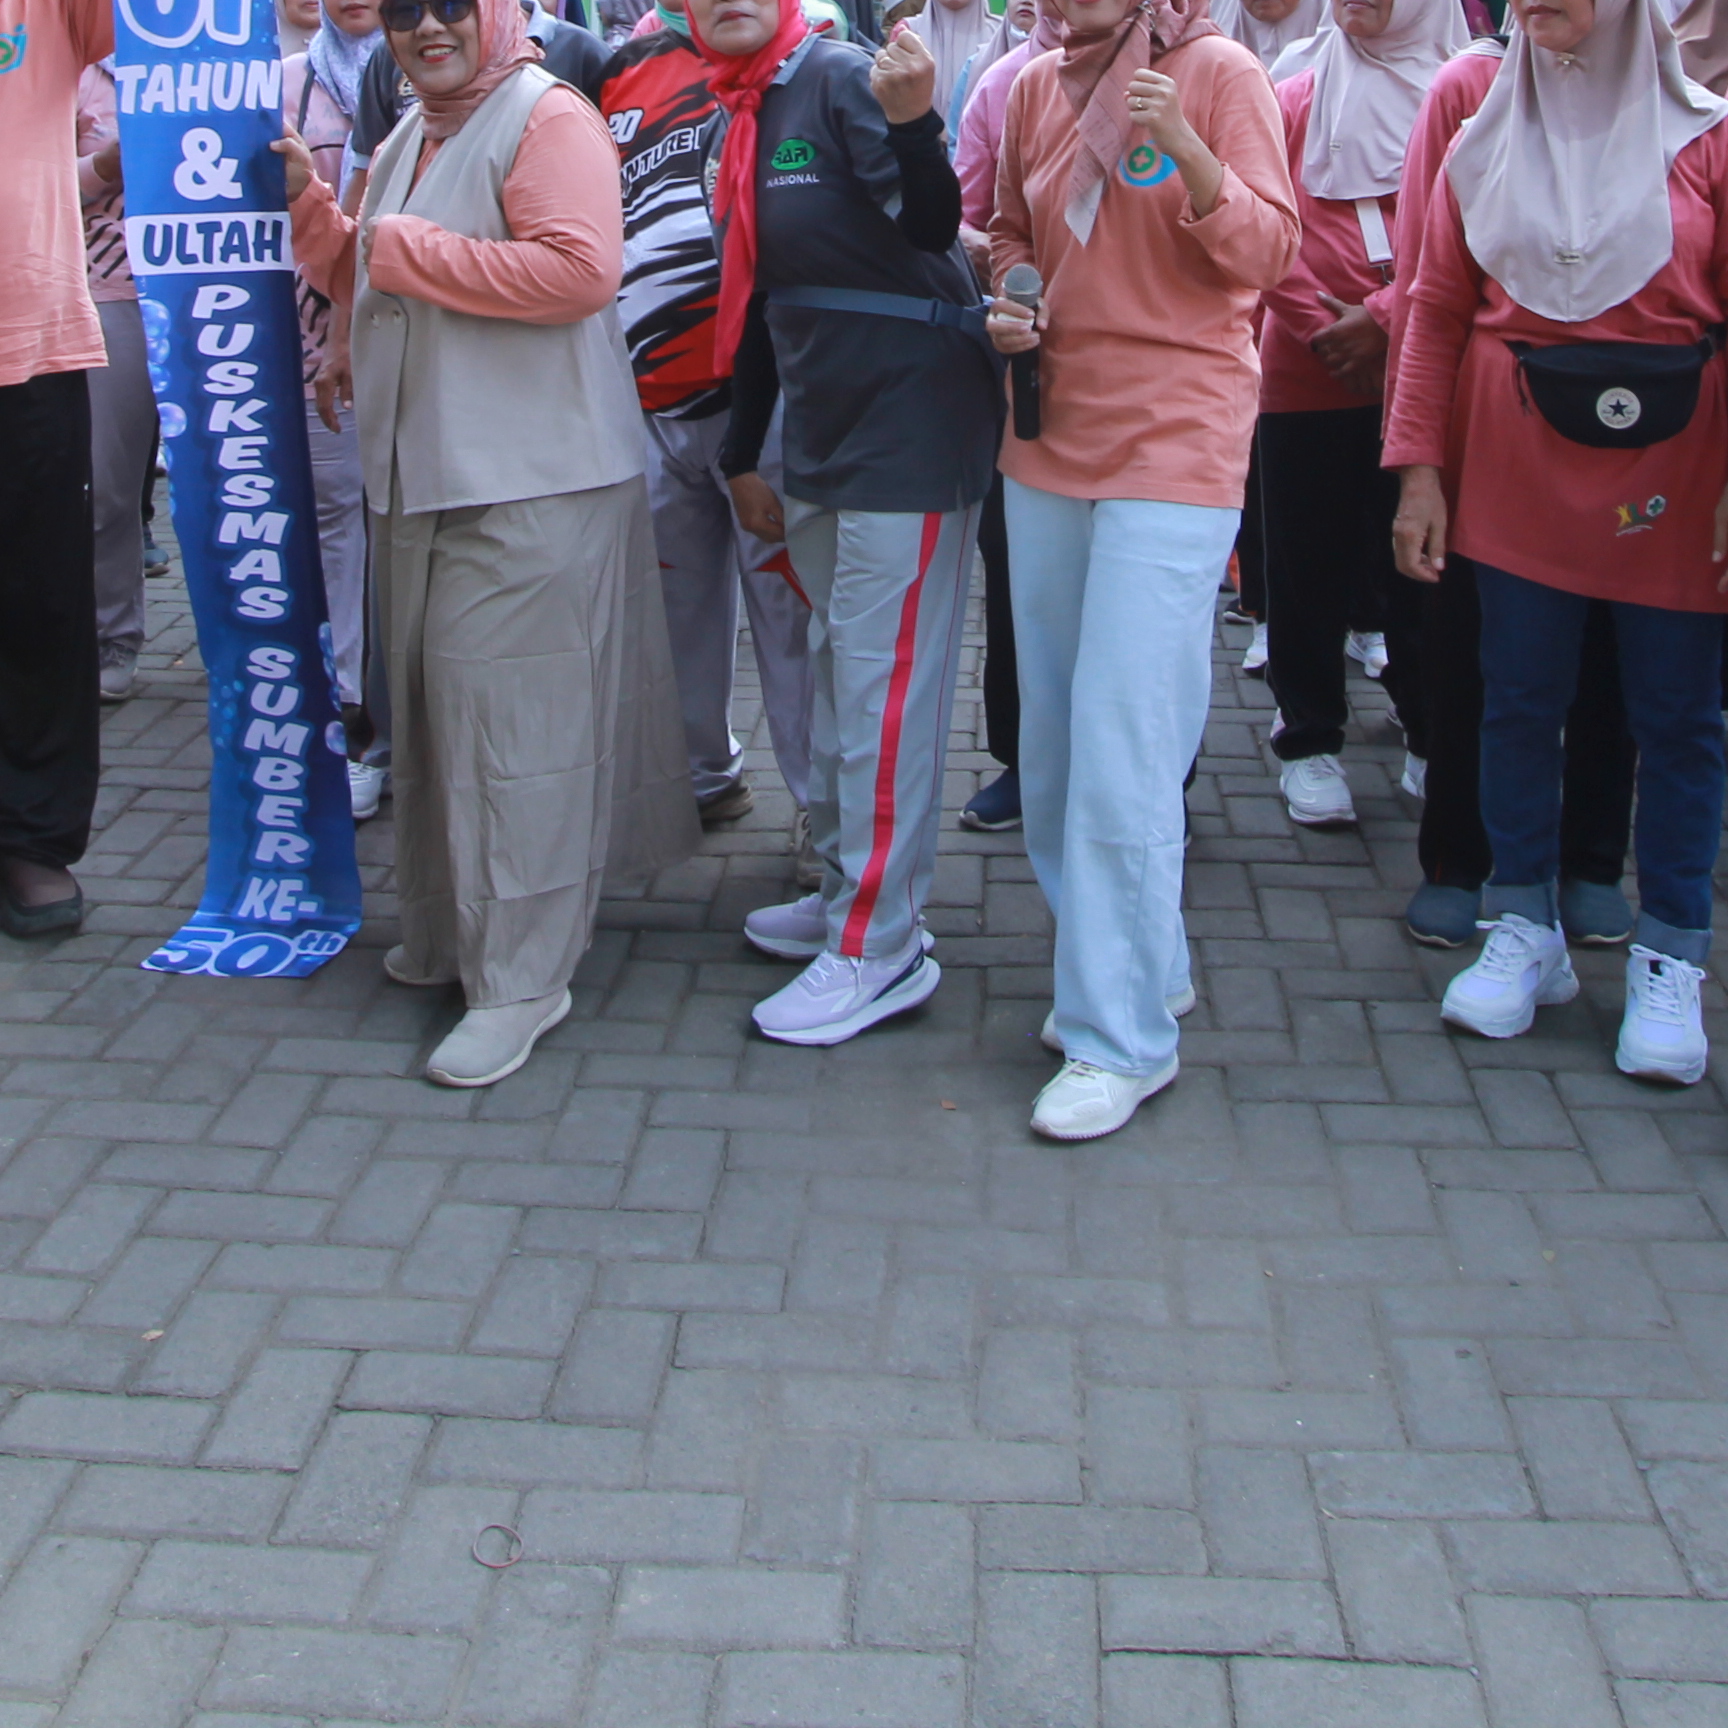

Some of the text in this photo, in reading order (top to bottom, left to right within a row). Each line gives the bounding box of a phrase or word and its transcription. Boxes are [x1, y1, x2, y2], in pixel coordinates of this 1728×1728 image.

[114, 60, 282, 116] TAHUN
[173, 126, 243, 201] &
[765, 172, 821, 189] NASIONAL
[142, 218, 283, 267] ULTAH
[191, 284, 311, 866] PUSKESMAS SUMBER
[238, 877, 320, 922] KE-
